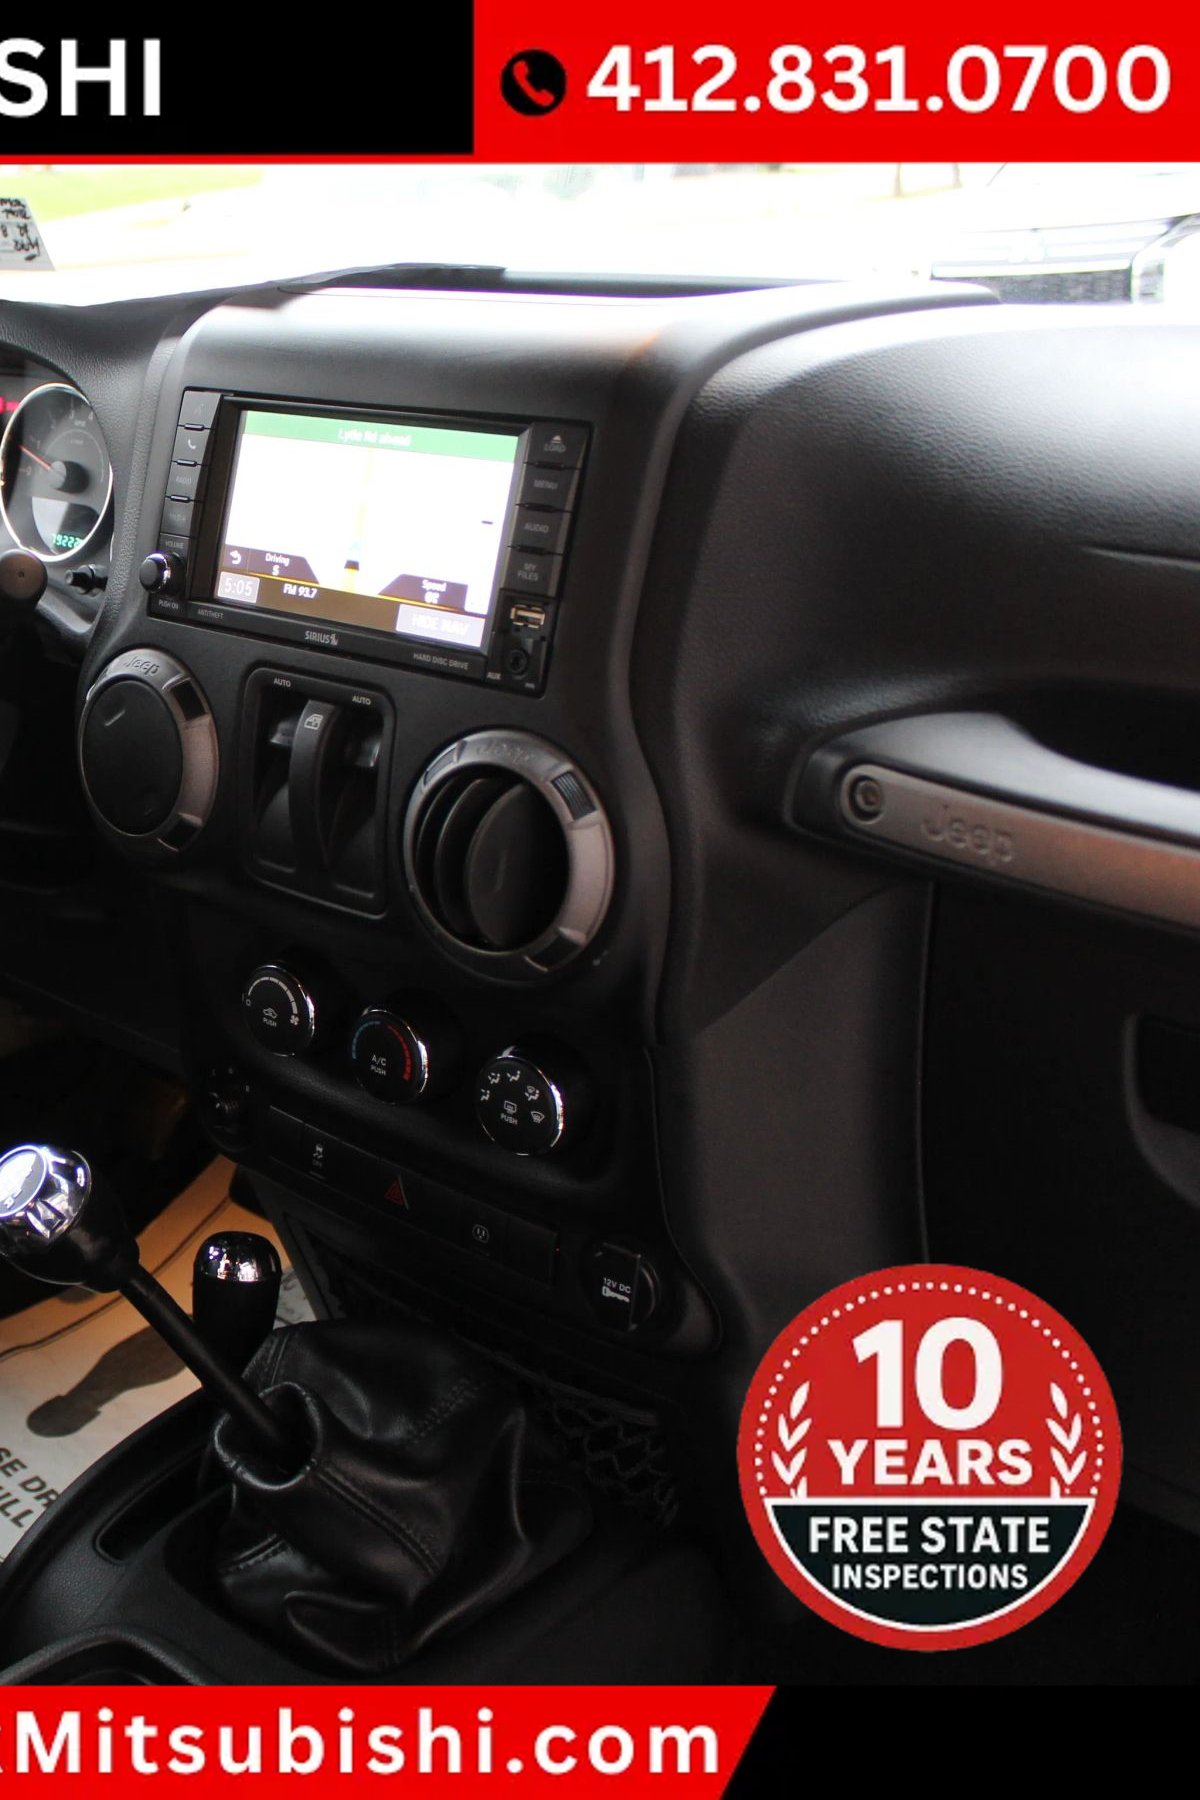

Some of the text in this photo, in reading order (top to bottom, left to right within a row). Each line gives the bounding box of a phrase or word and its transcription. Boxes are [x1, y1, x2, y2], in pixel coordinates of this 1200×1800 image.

[524, 523, 549, 534] AUDIO
[265, 553, 290, 567] Driving
[517, 571, 539, 582] FILES
[224, 577, 253, 596] 5:05
[283, 583, 318, 599] FM 93.7
[304, 630, 331, 644] SIRIUS
[123, 656, 160, 677] Jeep
[413, 652, 469, 671] HARD DISC DRIVE
[273, 677, 292, 688] AUTO
[351, 695, 372, 706] AUTO
[920, 812, 1014, 866] Jeep
[262, 1018, 278, 1028] PUSH
[371, 1053, 388, 1067] A/C
[370, 1064, 387, 1076] PUSH
[500, 1112, 519, 1126] PUSH
[603, 1276, 632, 1294] 12V DC
[17, 1475, 61, 1508] DR
